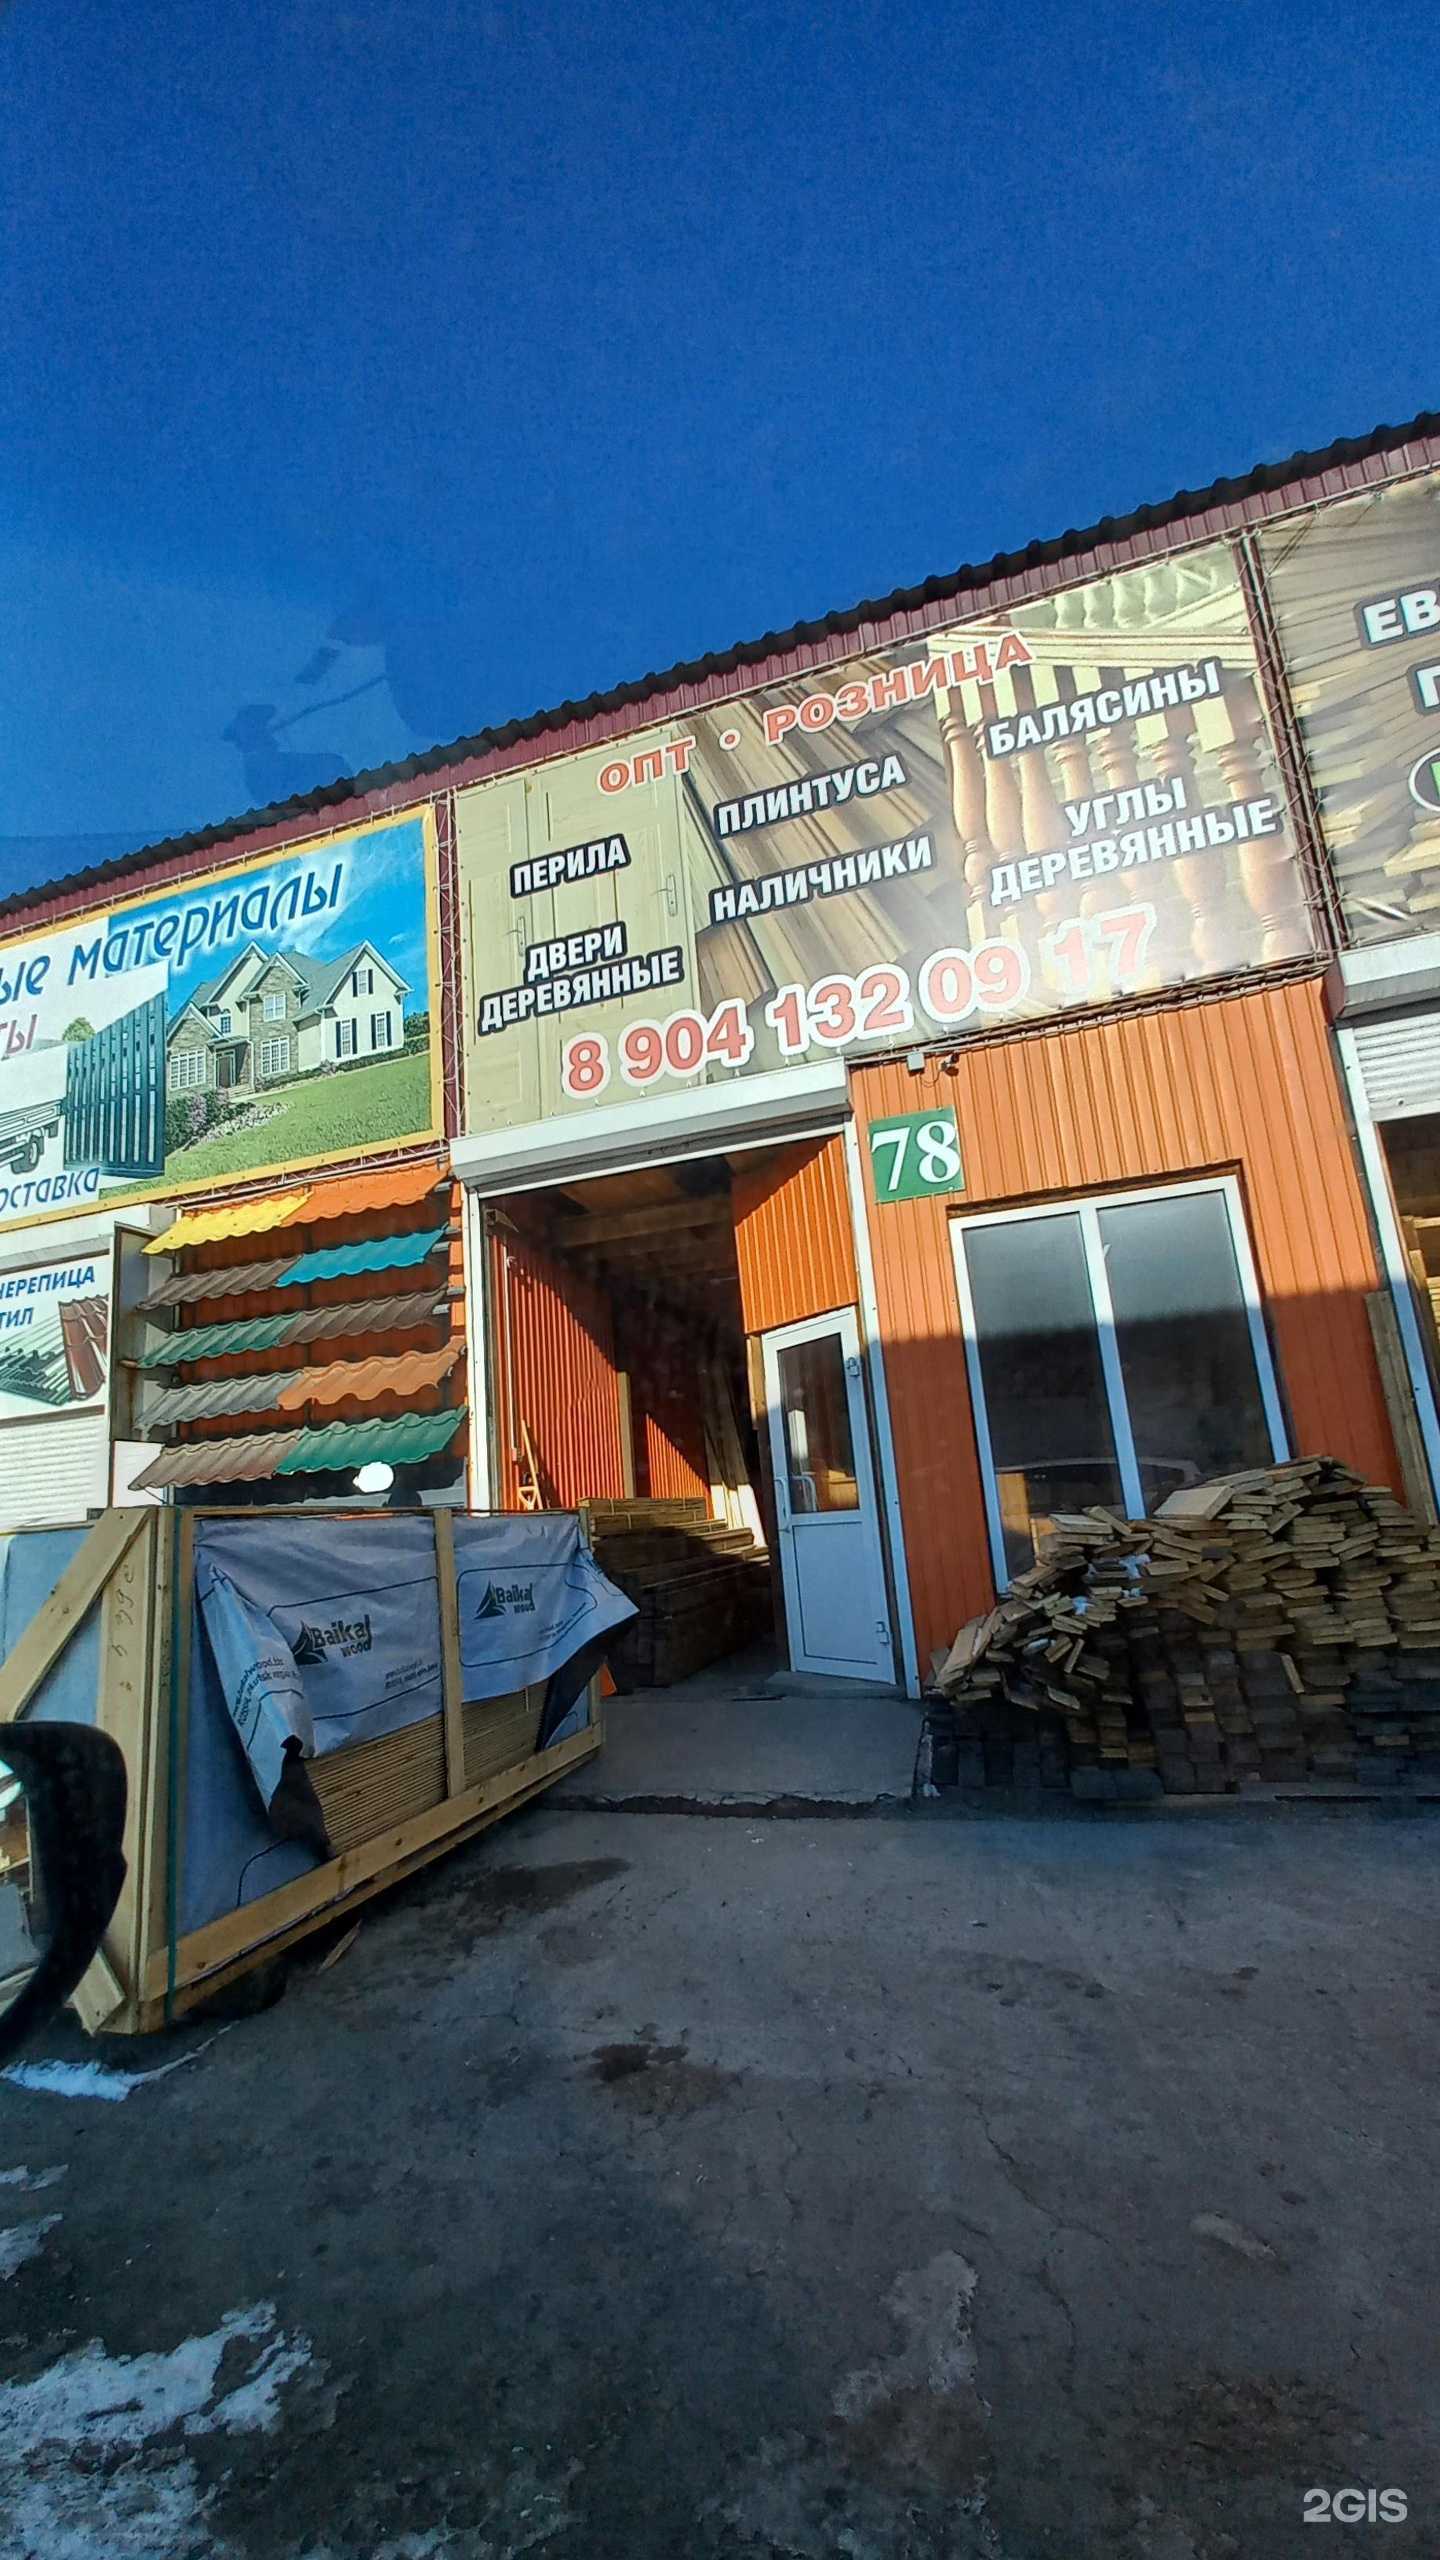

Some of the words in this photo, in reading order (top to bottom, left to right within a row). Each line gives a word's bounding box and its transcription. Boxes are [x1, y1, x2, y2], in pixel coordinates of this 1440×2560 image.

[598, 737, 696, 794] ОПТ
[766, 633, 1034, 745] РОЗНИЦА
[988, 661, 1221, 758] БАЛЯСИНЫ
[717, 755, 907, 836] ПЛИНТУСА
[1064, 777, 1188, 839] УГЛЫ
[513, 837, 627, 895] ПЕРИЛА
[713, 835, 933, 923] НАЛИЧНИКИ
[989, 798, 1278, 907] ДЕРЕВЯННЫЕ
[481, 950, 681, 1033] ДЕРЕВЯННЫЕ
[527, 926, 624, 982] ДВЕРИ
[566, 1036, 606, 1094] 8
[622, 1004, 749, 1081] 904
[771, 970, 907, 1049] 132
[925, 943, 1025, 1014] 09
[1053, 908, 1150, 993] 17
[870, 1120, 961, 1192] 78
[495, 1582, 534, 1604] Baikal
[309, 1614, 372, 1650] Baikal
[341, 1639, 372, 1658] wood
